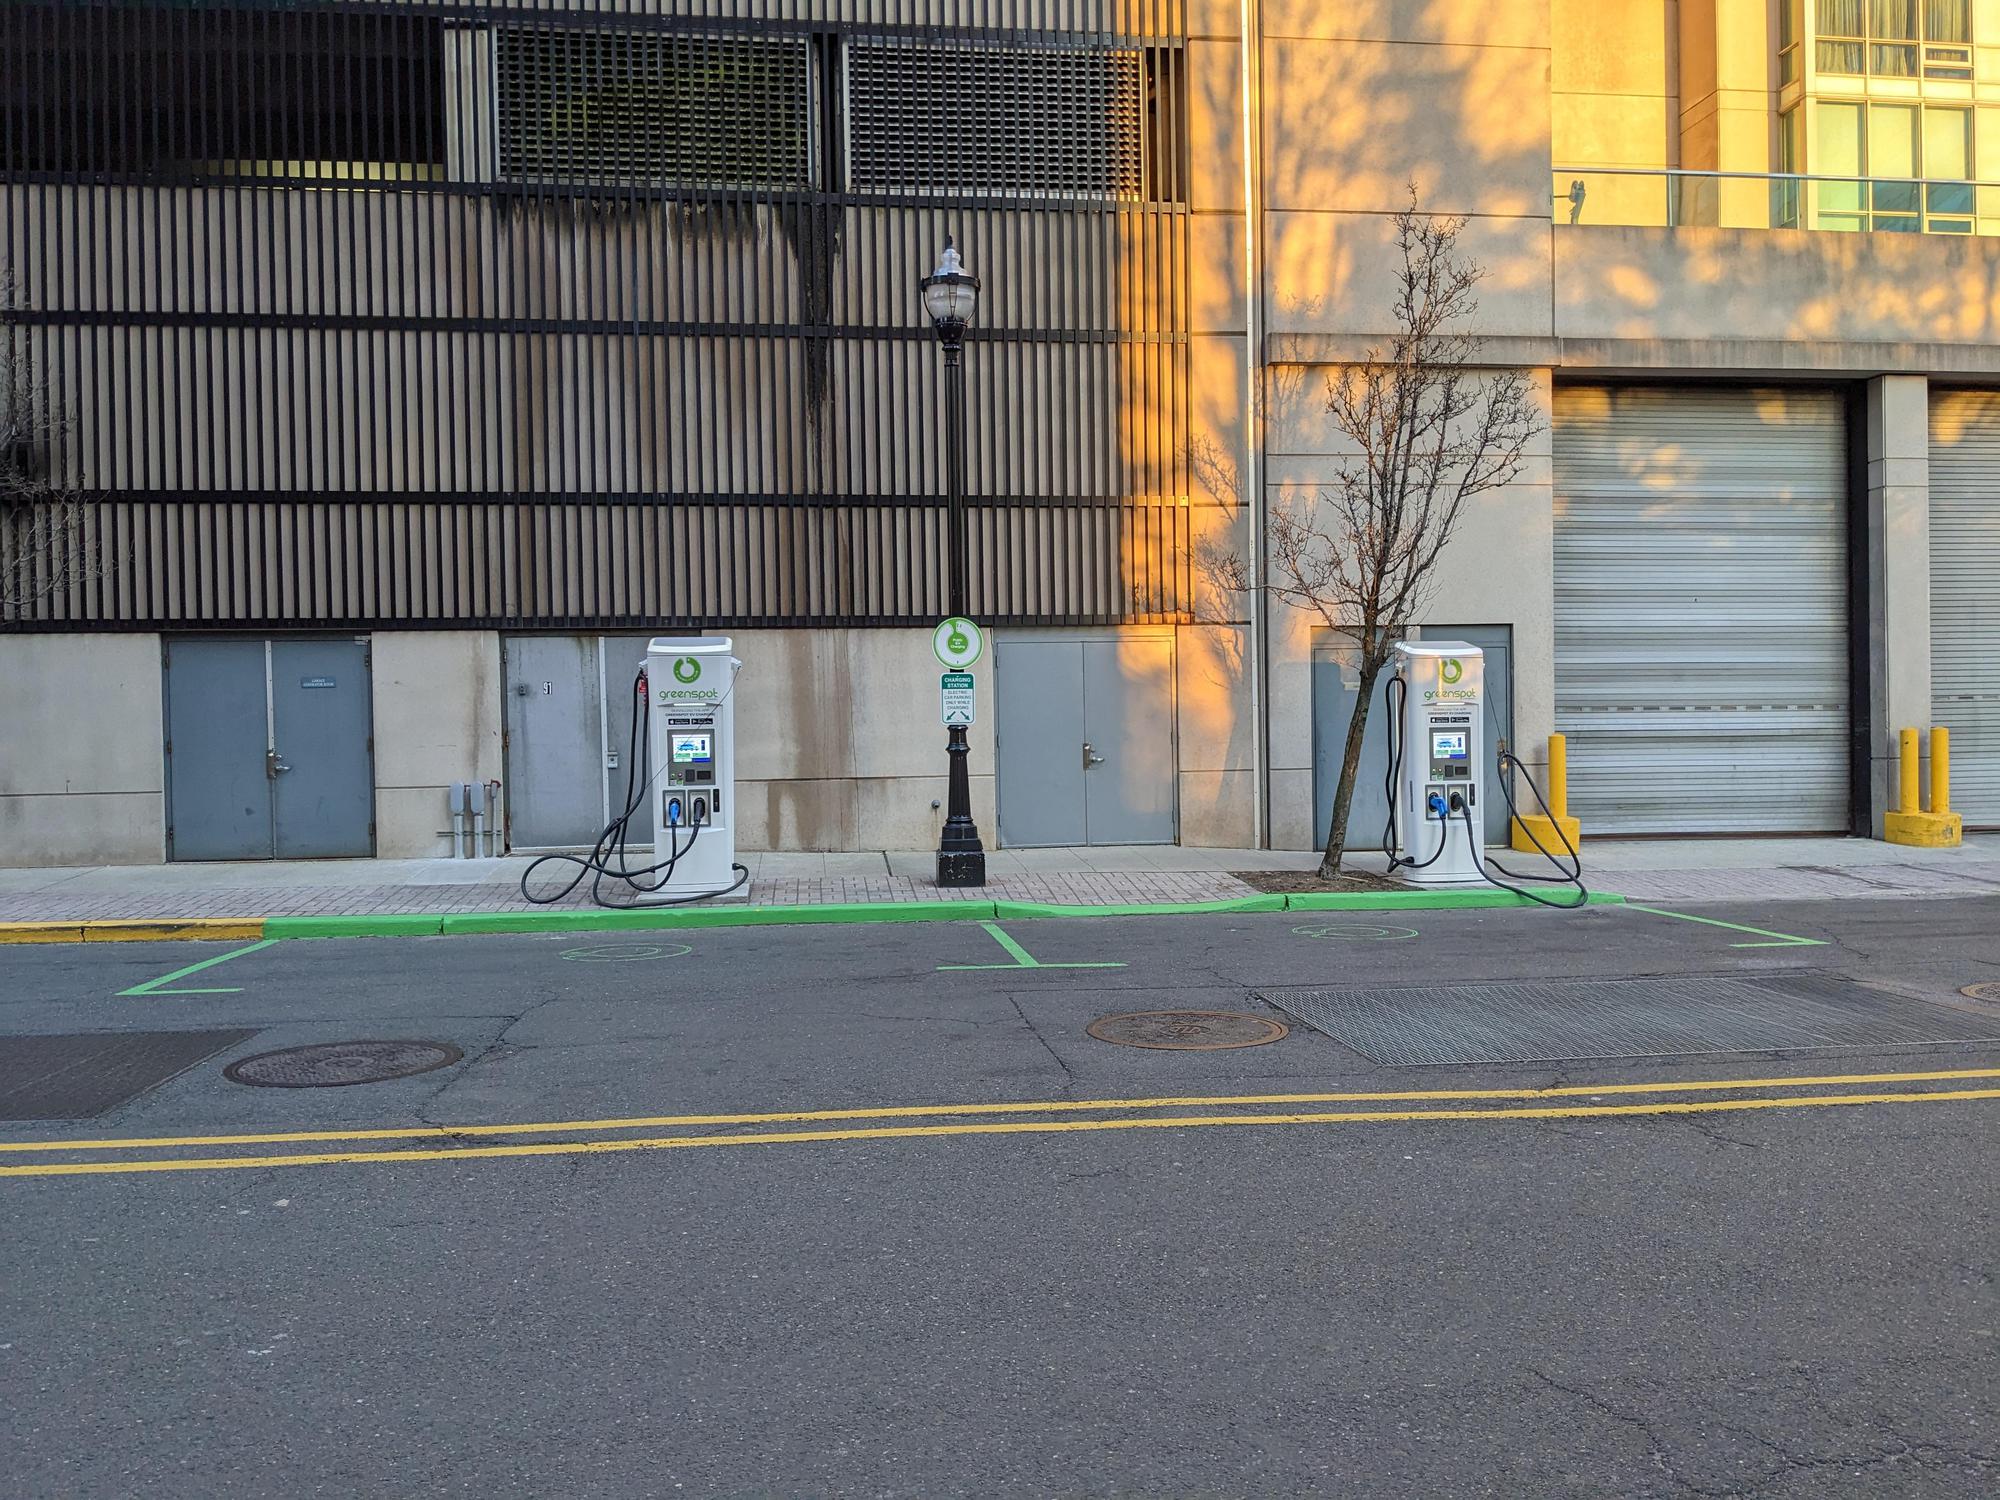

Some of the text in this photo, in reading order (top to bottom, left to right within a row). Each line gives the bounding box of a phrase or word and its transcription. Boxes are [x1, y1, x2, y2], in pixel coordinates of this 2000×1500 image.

[543, 681, 552, 695] 91
[659, 688, 718, 701] greenspot
[1424, 688, 1476, 700] greenspot
